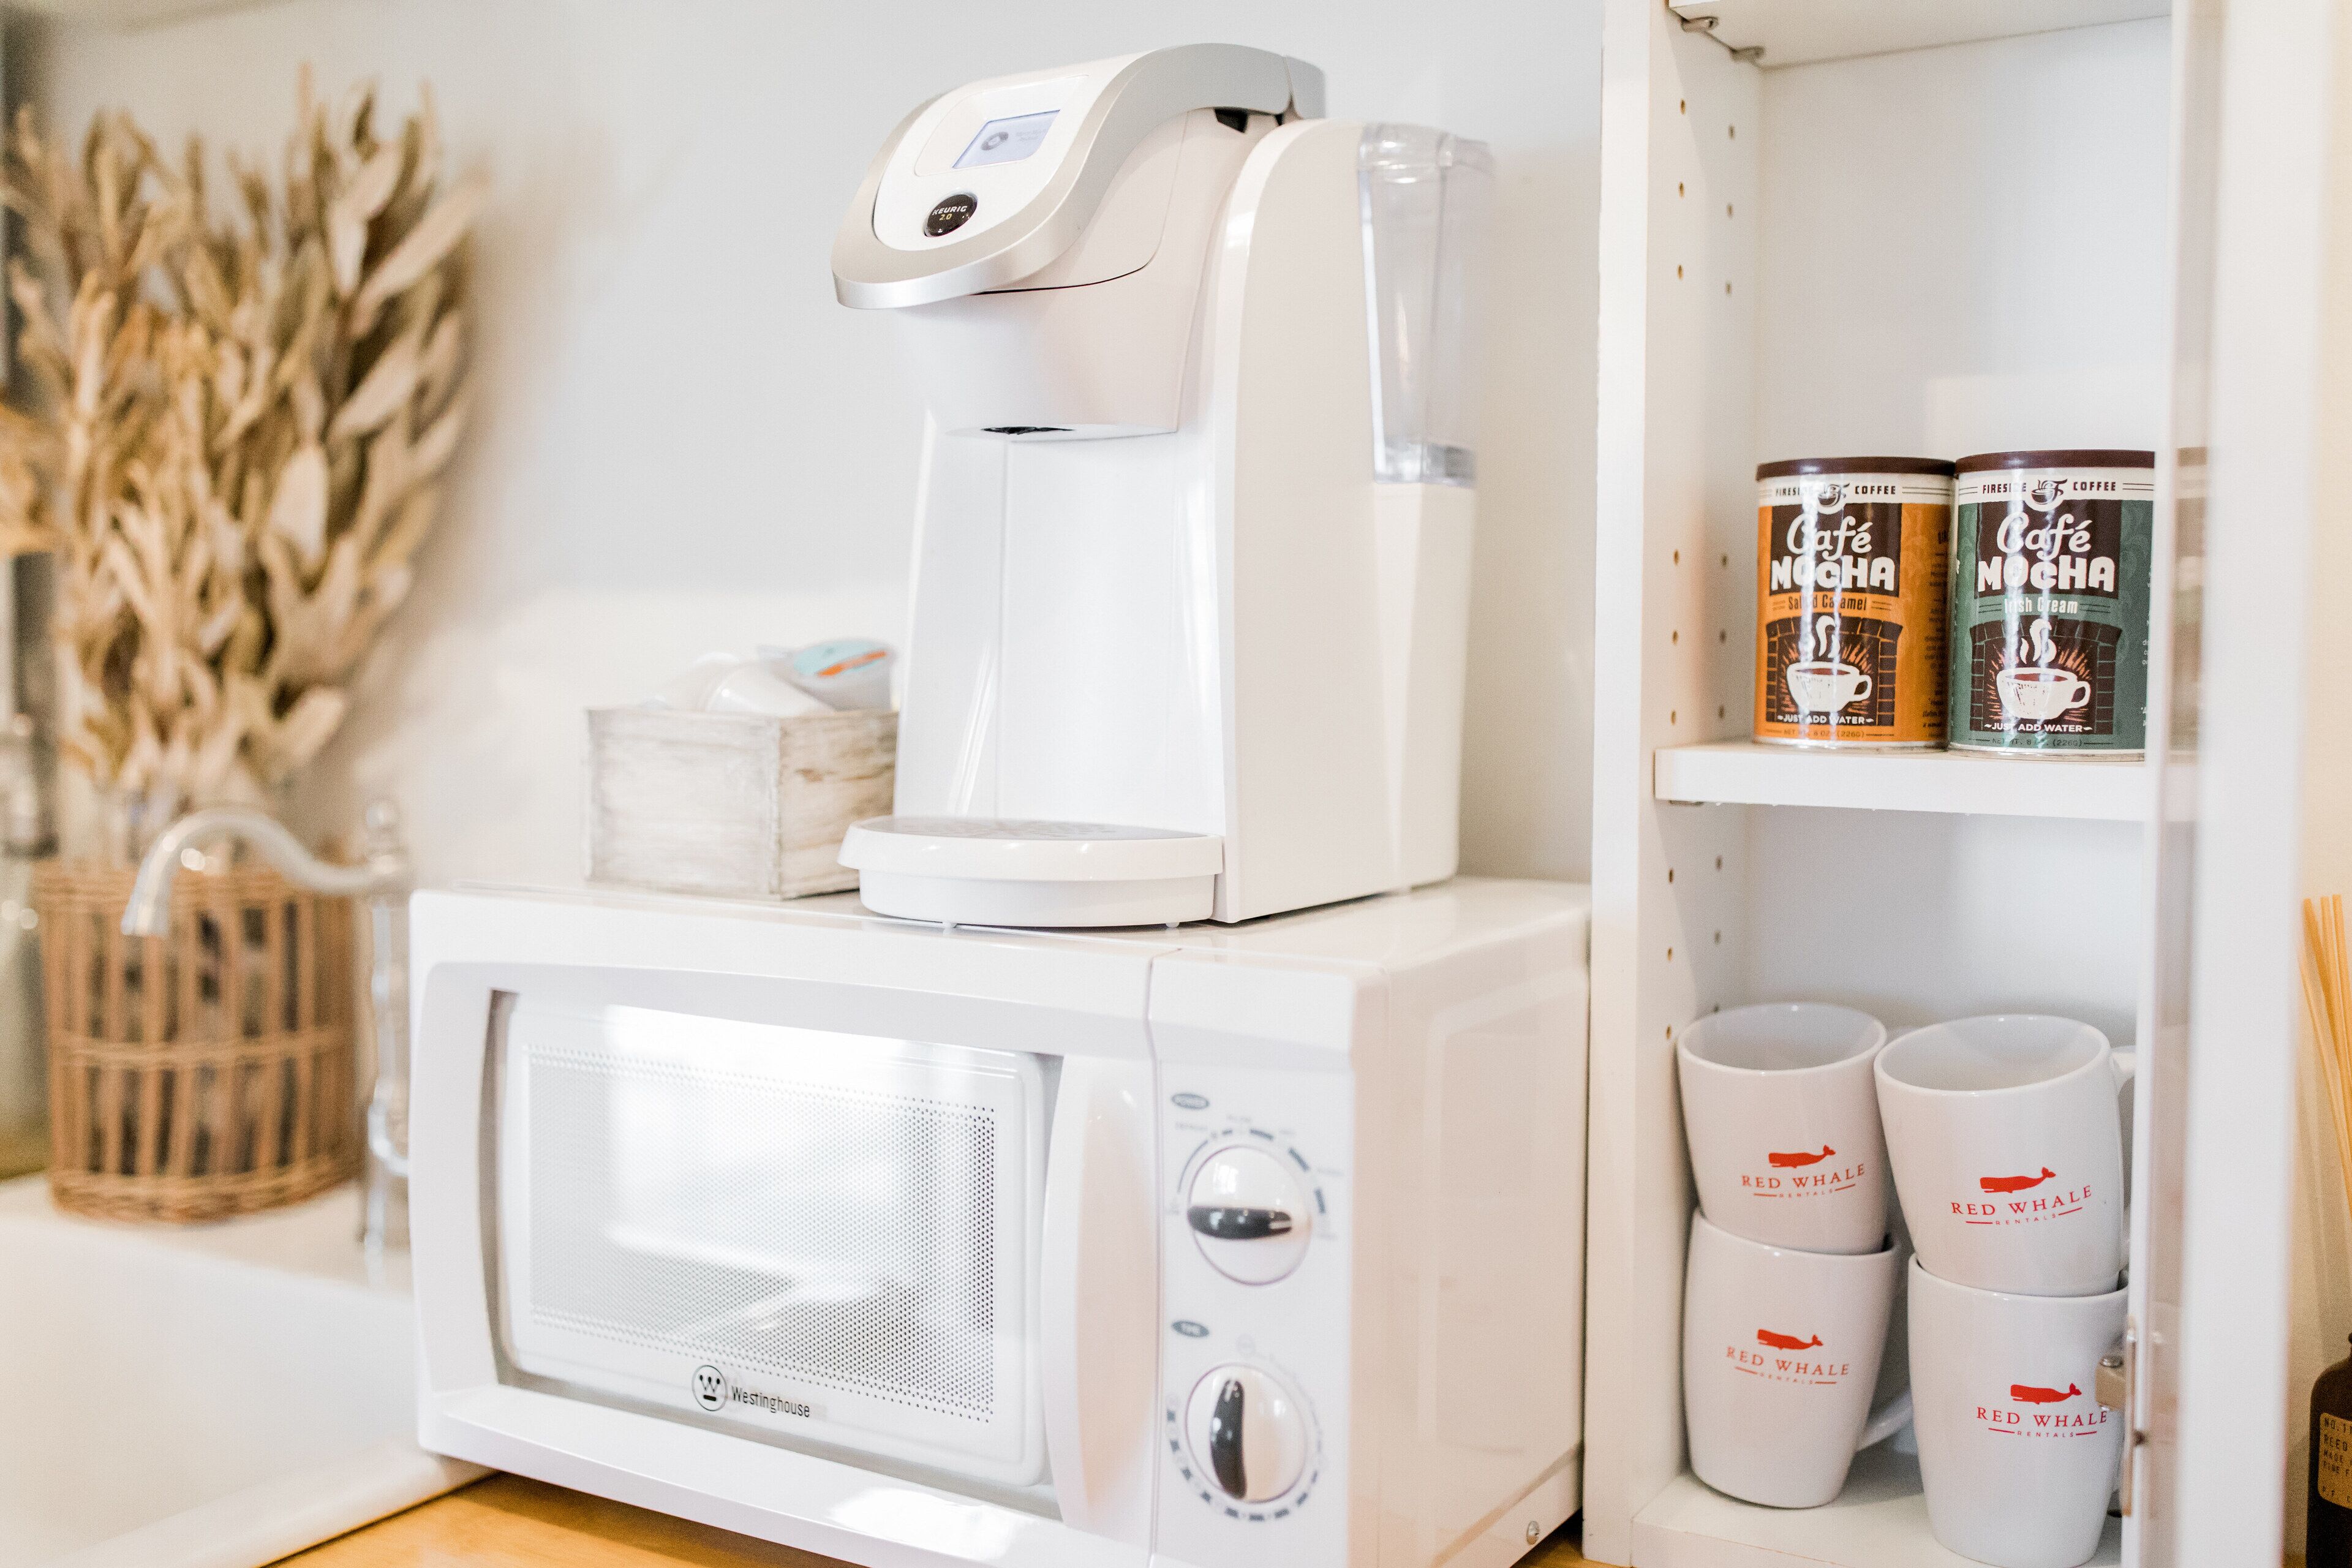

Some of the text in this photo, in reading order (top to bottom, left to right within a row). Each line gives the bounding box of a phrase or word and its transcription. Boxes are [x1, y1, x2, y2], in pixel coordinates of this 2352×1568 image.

[932, 205, 968, 216] KEURIG
[1855, 486, 1896, 494] COFFEE
[2073, 481, 2116, 491] COFFEE
[1786, 513, 1873, 561] Café
[1997, 511, 2092, 561] Café
[1771, 555, 1895, 591] MOCHA
[1977, 554, 2115, 592] MOCHA
[1822, 594, 1867, 611] Caamel
[2037, 596, 2078, 614] Cream
[1784, 714, 1803, 723] JUST
[1807, 714, 1827, 723] ADD
[1992, 722, 2082, 733] JUST ADD WATER
[1741, 1164, 1865, 1189] RED WHALE
[1951, 1185, 2092, 1216] RED WHALE
[1996, 1213, 2056, 1225] RENTALS
[1726, 1346, 1849, 1376] RED WHALE
[731, 1385, 810, 1418] Westinghouse
[1977, 1407, 2107, 1427] RED WHALE
